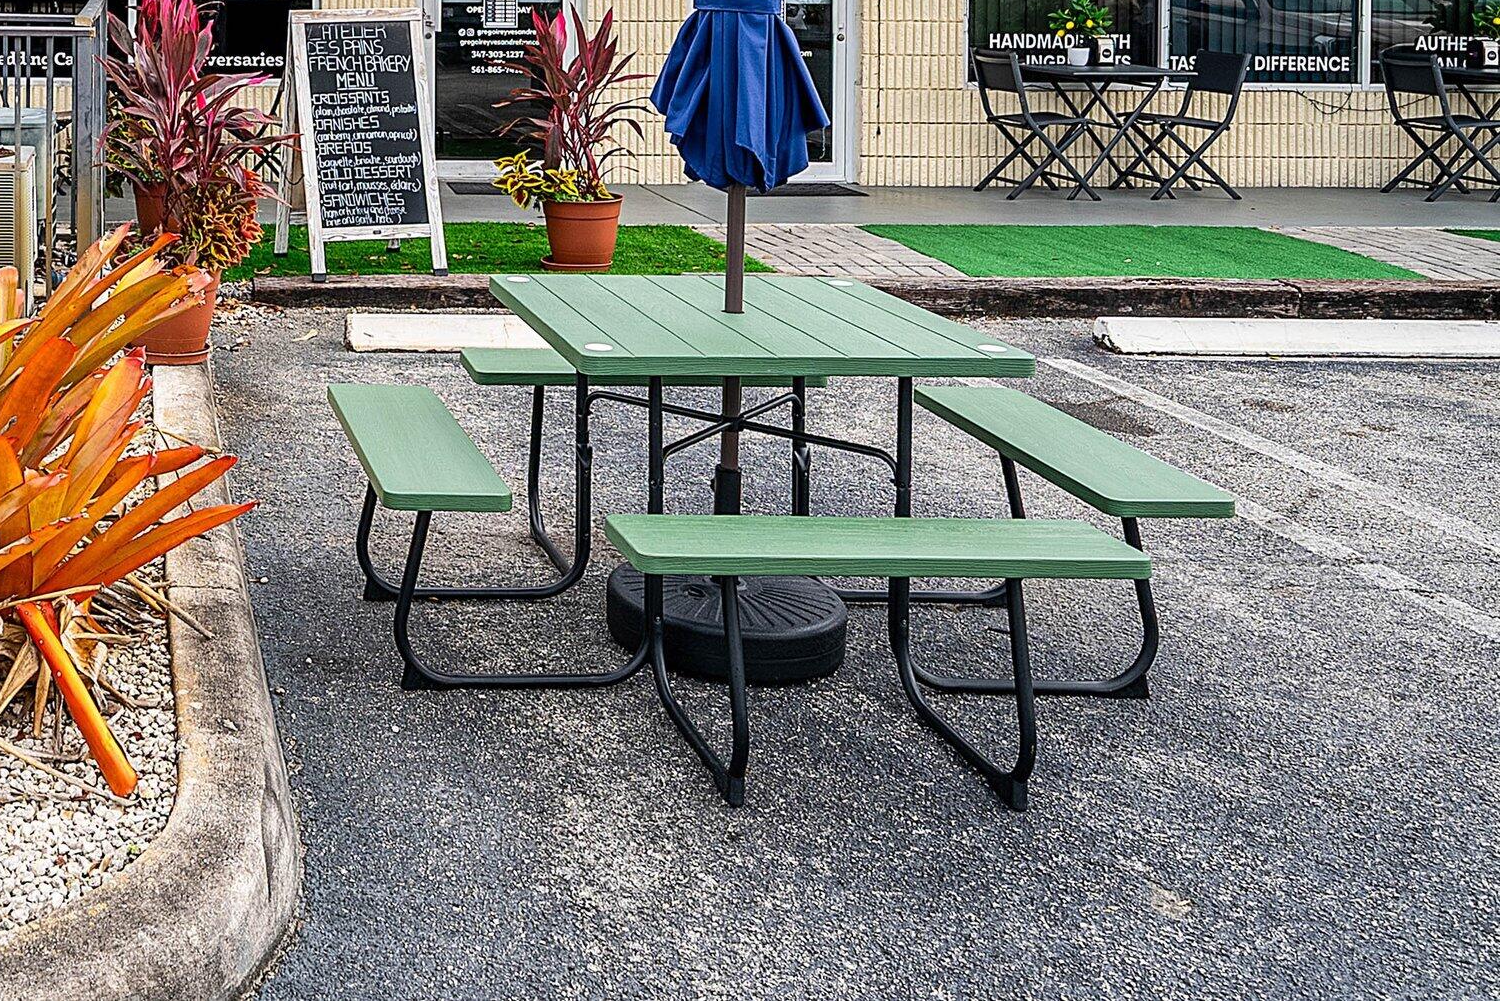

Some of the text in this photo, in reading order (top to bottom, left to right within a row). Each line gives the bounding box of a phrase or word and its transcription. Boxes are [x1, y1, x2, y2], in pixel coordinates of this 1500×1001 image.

[466, 6, 484, 14] OPE
[308, 39, 383, 55] DES PAINS
[1415, 36, 1474, 51] AUTHE
[204, 51, 284, 66] versaries
[309, 55, 410, 72] FRENCH BAKERY
[1170, 56, 1350, 71] TAS DIFFERENCE
[336, 72, 375, 88] MENU
[319, 142, 372, 155] BREADS
[320, 165, 411, 180] COLD DESSERT
